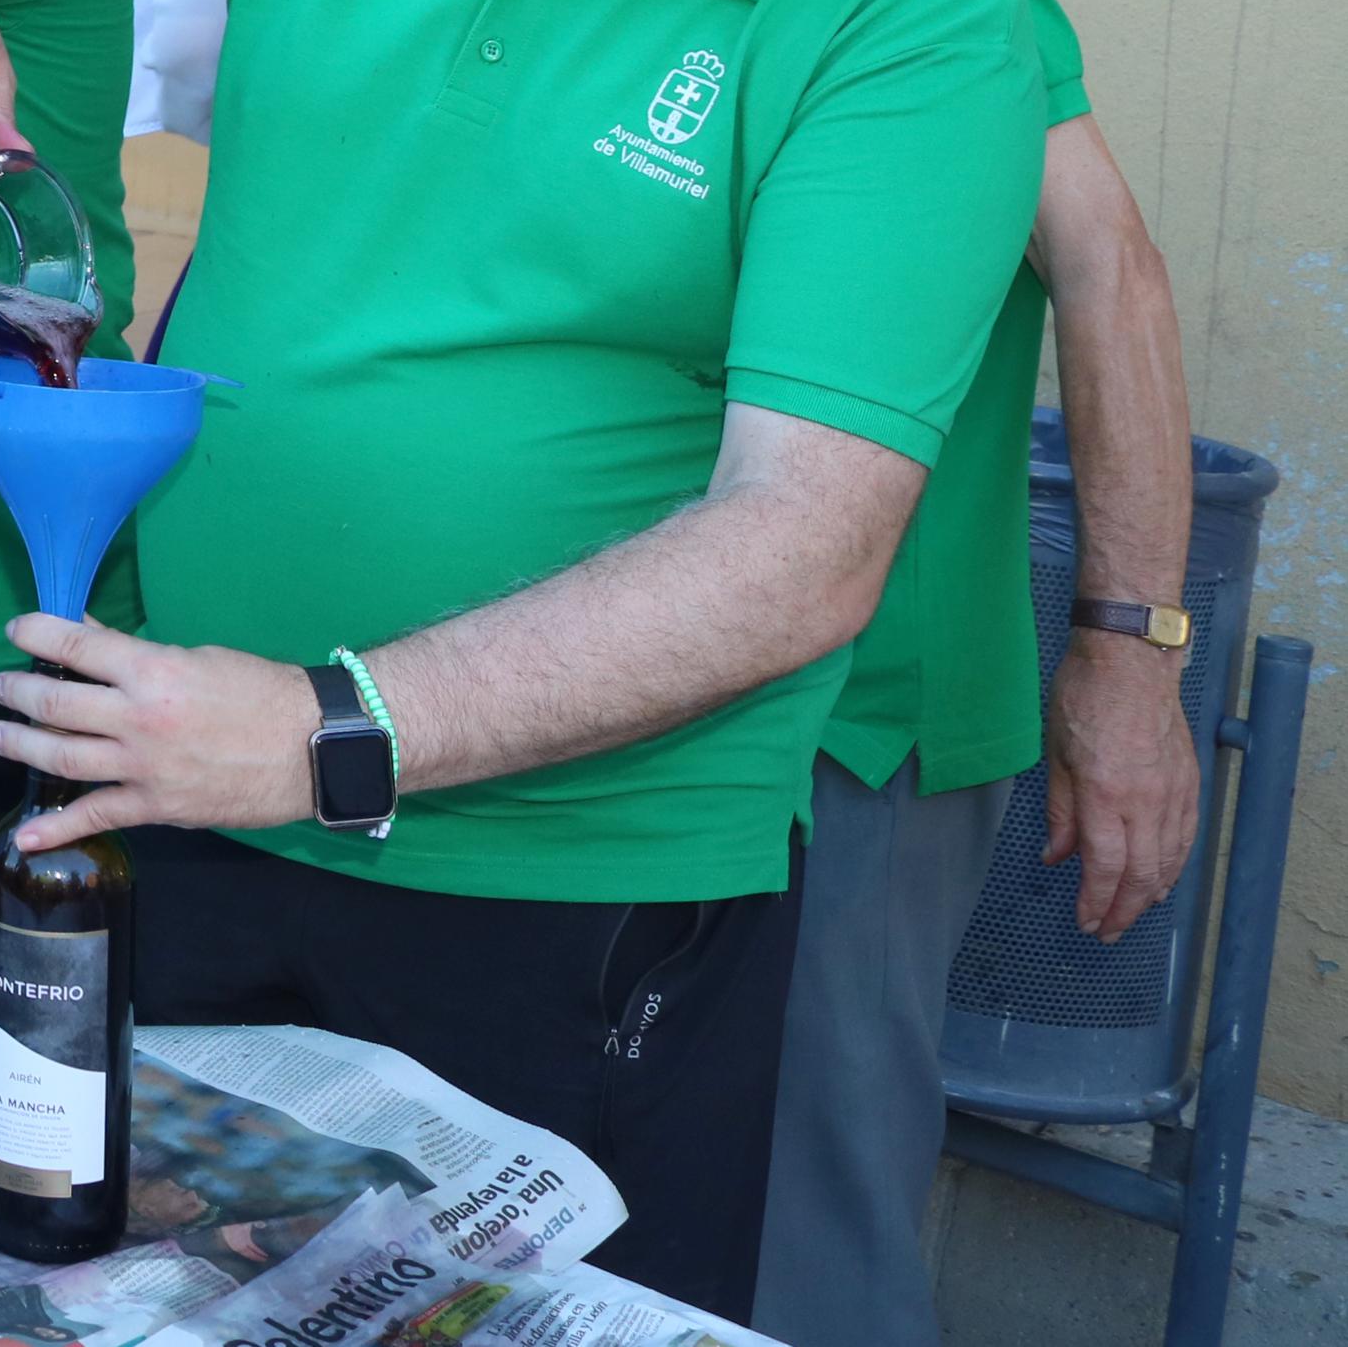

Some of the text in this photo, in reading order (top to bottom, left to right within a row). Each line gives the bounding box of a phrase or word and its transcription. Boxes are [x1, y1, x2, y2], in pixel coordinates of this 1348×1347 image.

[593, 137, 710, 200] de Villamuriel
[608, 123, 705, 176] Ayuntamiento
[8, 1071, 42, 1085] AIRÉN
[8, 1097, 66, 1115] MANCHA
[428, 1154, 533, 1234] a la leyenda
[518, 1169, 565, 1205] Una
[448, 1203, 529, 1262] ‘orejon
[493, 1206, 576, 1271] DEPORTES
[529, 1292, 576, 1342] donaciones
[572, 1301, 587, 1316] en
[585, 1300, 608, 1323] León
